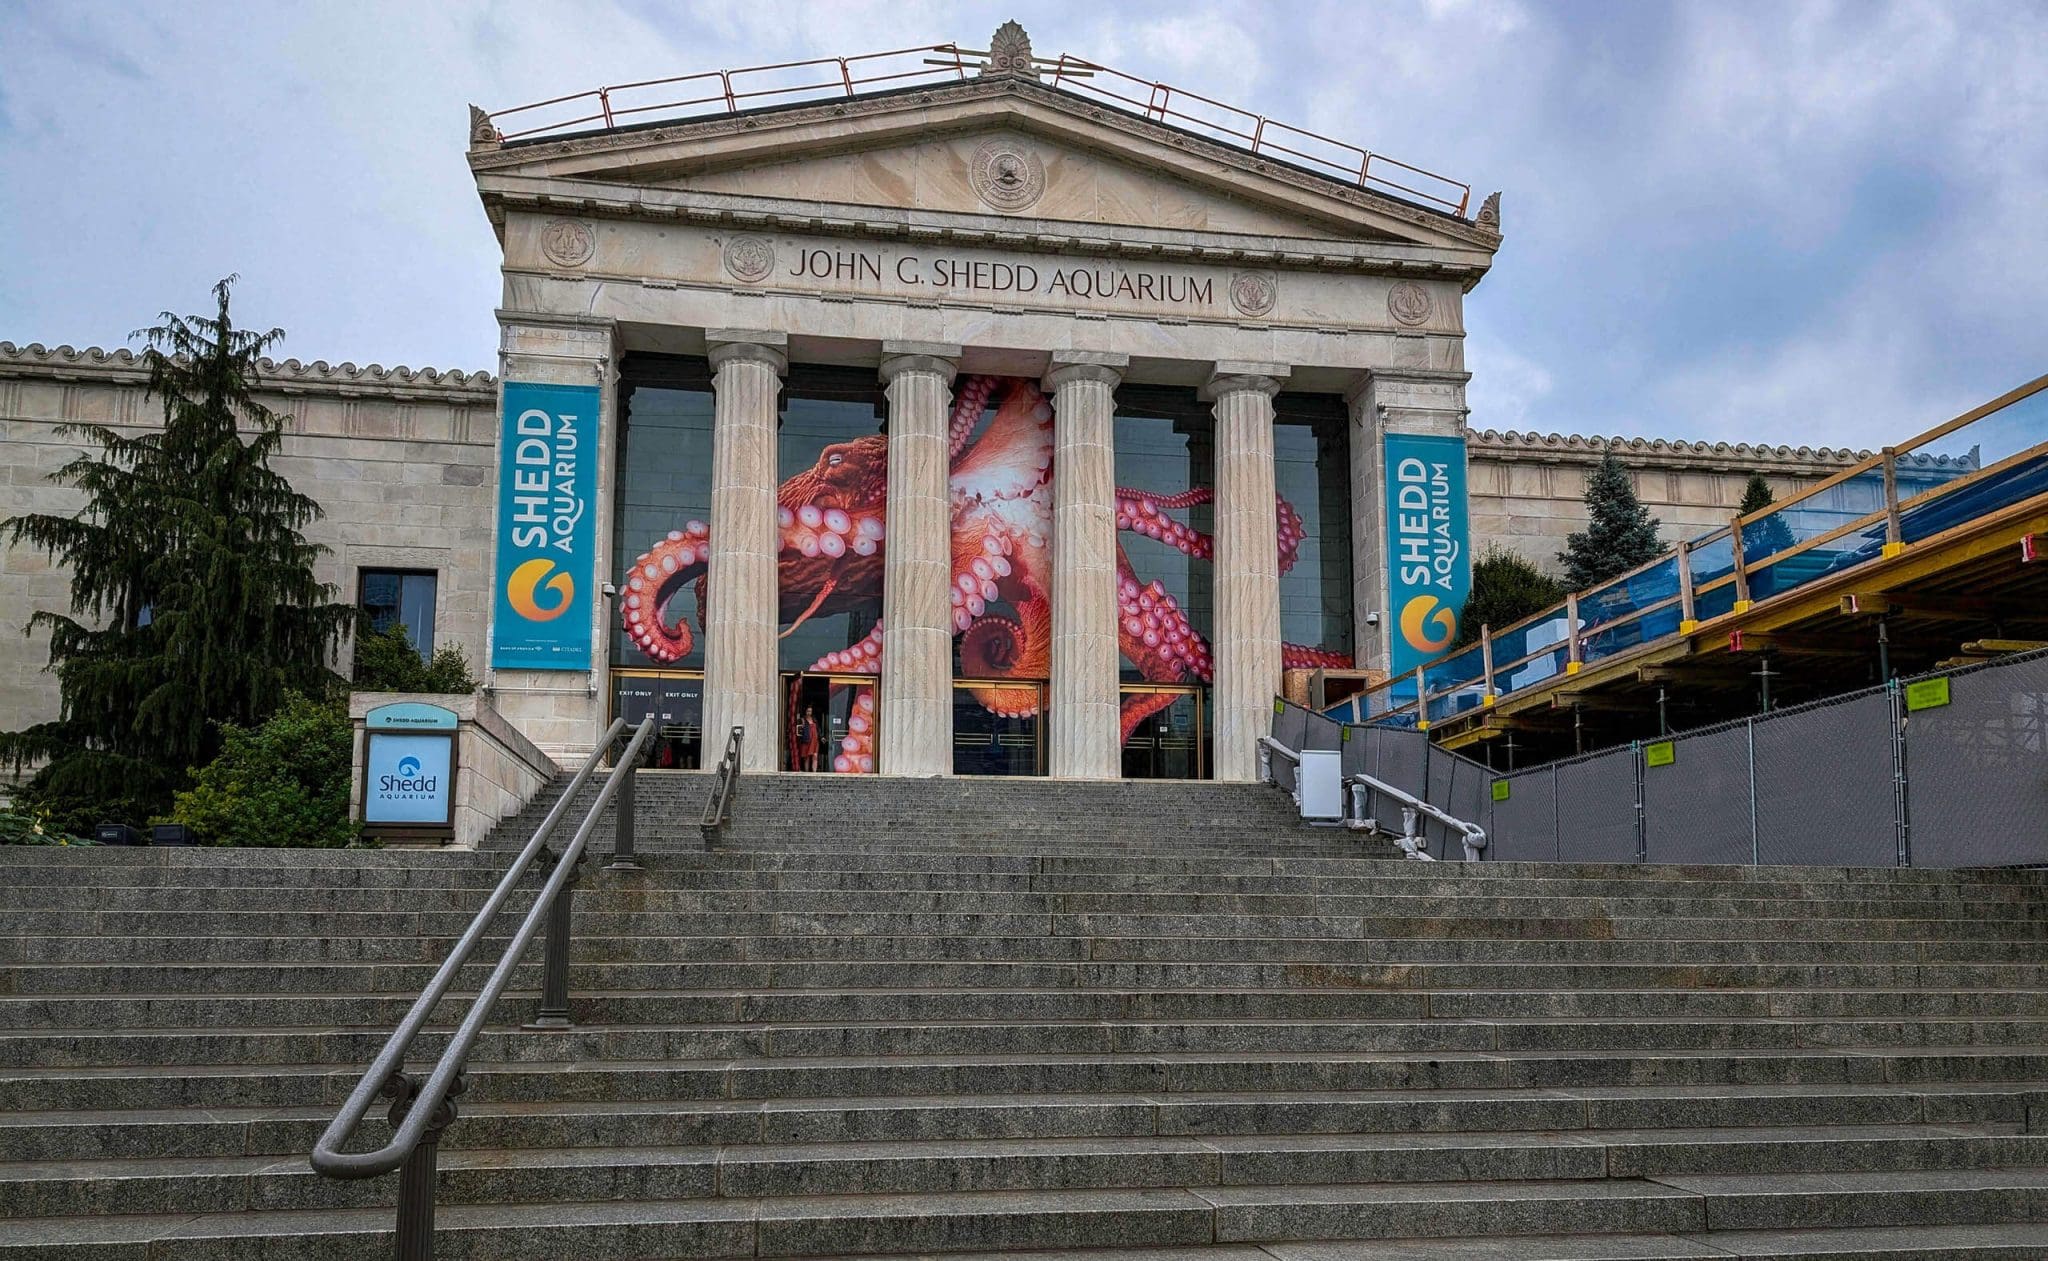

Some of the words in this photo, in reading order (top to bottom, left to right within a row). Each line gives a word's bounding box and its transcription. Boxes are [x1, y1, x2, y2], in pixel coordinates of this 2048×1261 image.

[789, 249, 882, 282] JOHN
[896, 257, 925, 285] G.
[932, 259, 1039, 292] SHEDD
[1048, 268, 1213, 304] AQUARIUM
[512, 409, 551, 548] SHEDD
[552, 414, 584, 553] AQUARIUM
[1398, 458, 1430, 585] SHEDD
[1431, 463, 1459, 590] AQUARIUM
[379, 775, 436, 791] Shedd
